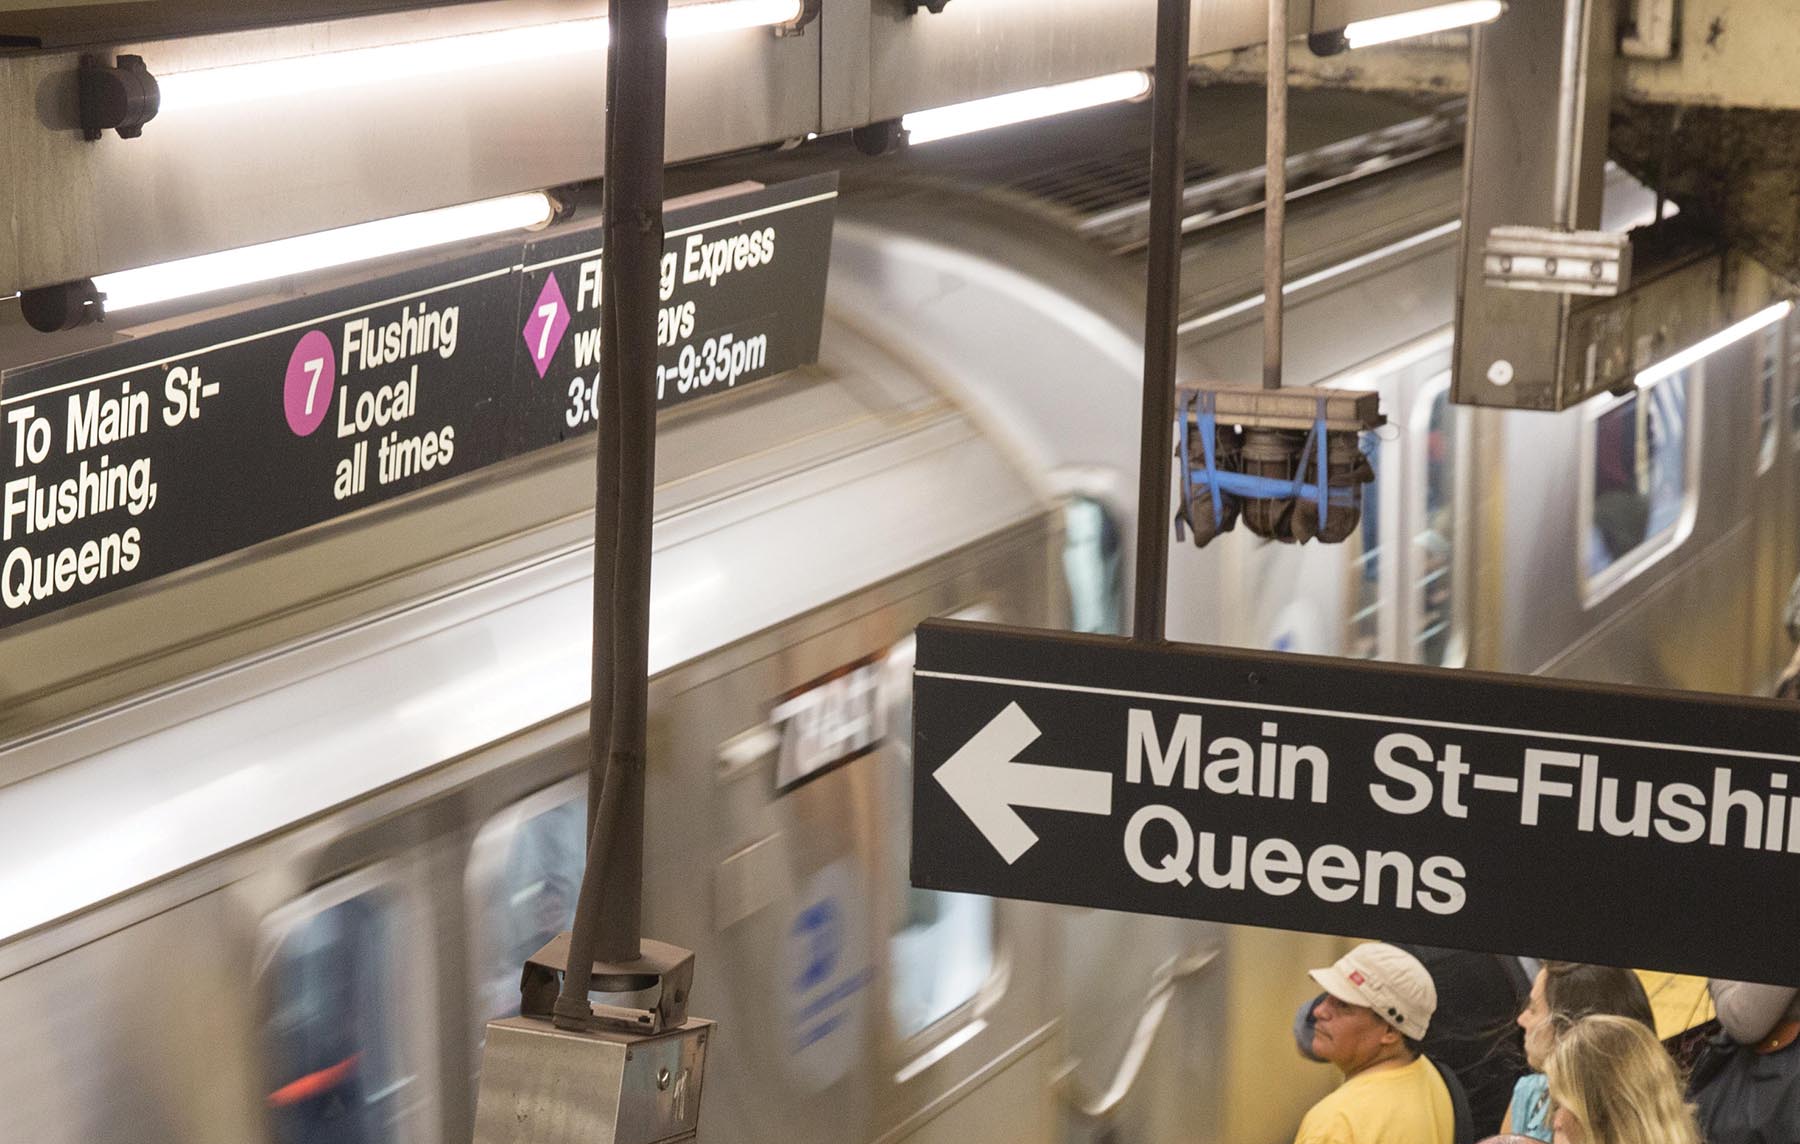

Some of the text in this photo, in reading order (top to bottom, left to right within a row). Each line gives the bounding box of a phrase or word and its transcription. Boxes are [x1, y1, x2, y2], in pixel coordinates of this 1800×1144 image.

[683, 227, 775, 286] Express
[341, 301, 460, 376] Flushing
[537, 301, 558, 360] 7
[7, 367, 220, 467] To Main St-
[303, 357, 325, 416] 7
[337, 365, 418, 438] Local
[3, 457, 158, 541] Flushing,
[334, 425, 455, 500] all times
[1, 526, 141, 609] Queens
[1124, 708, 1800, 854] Main St-Flushi
[1123, 804, 1467, 915] Queens
